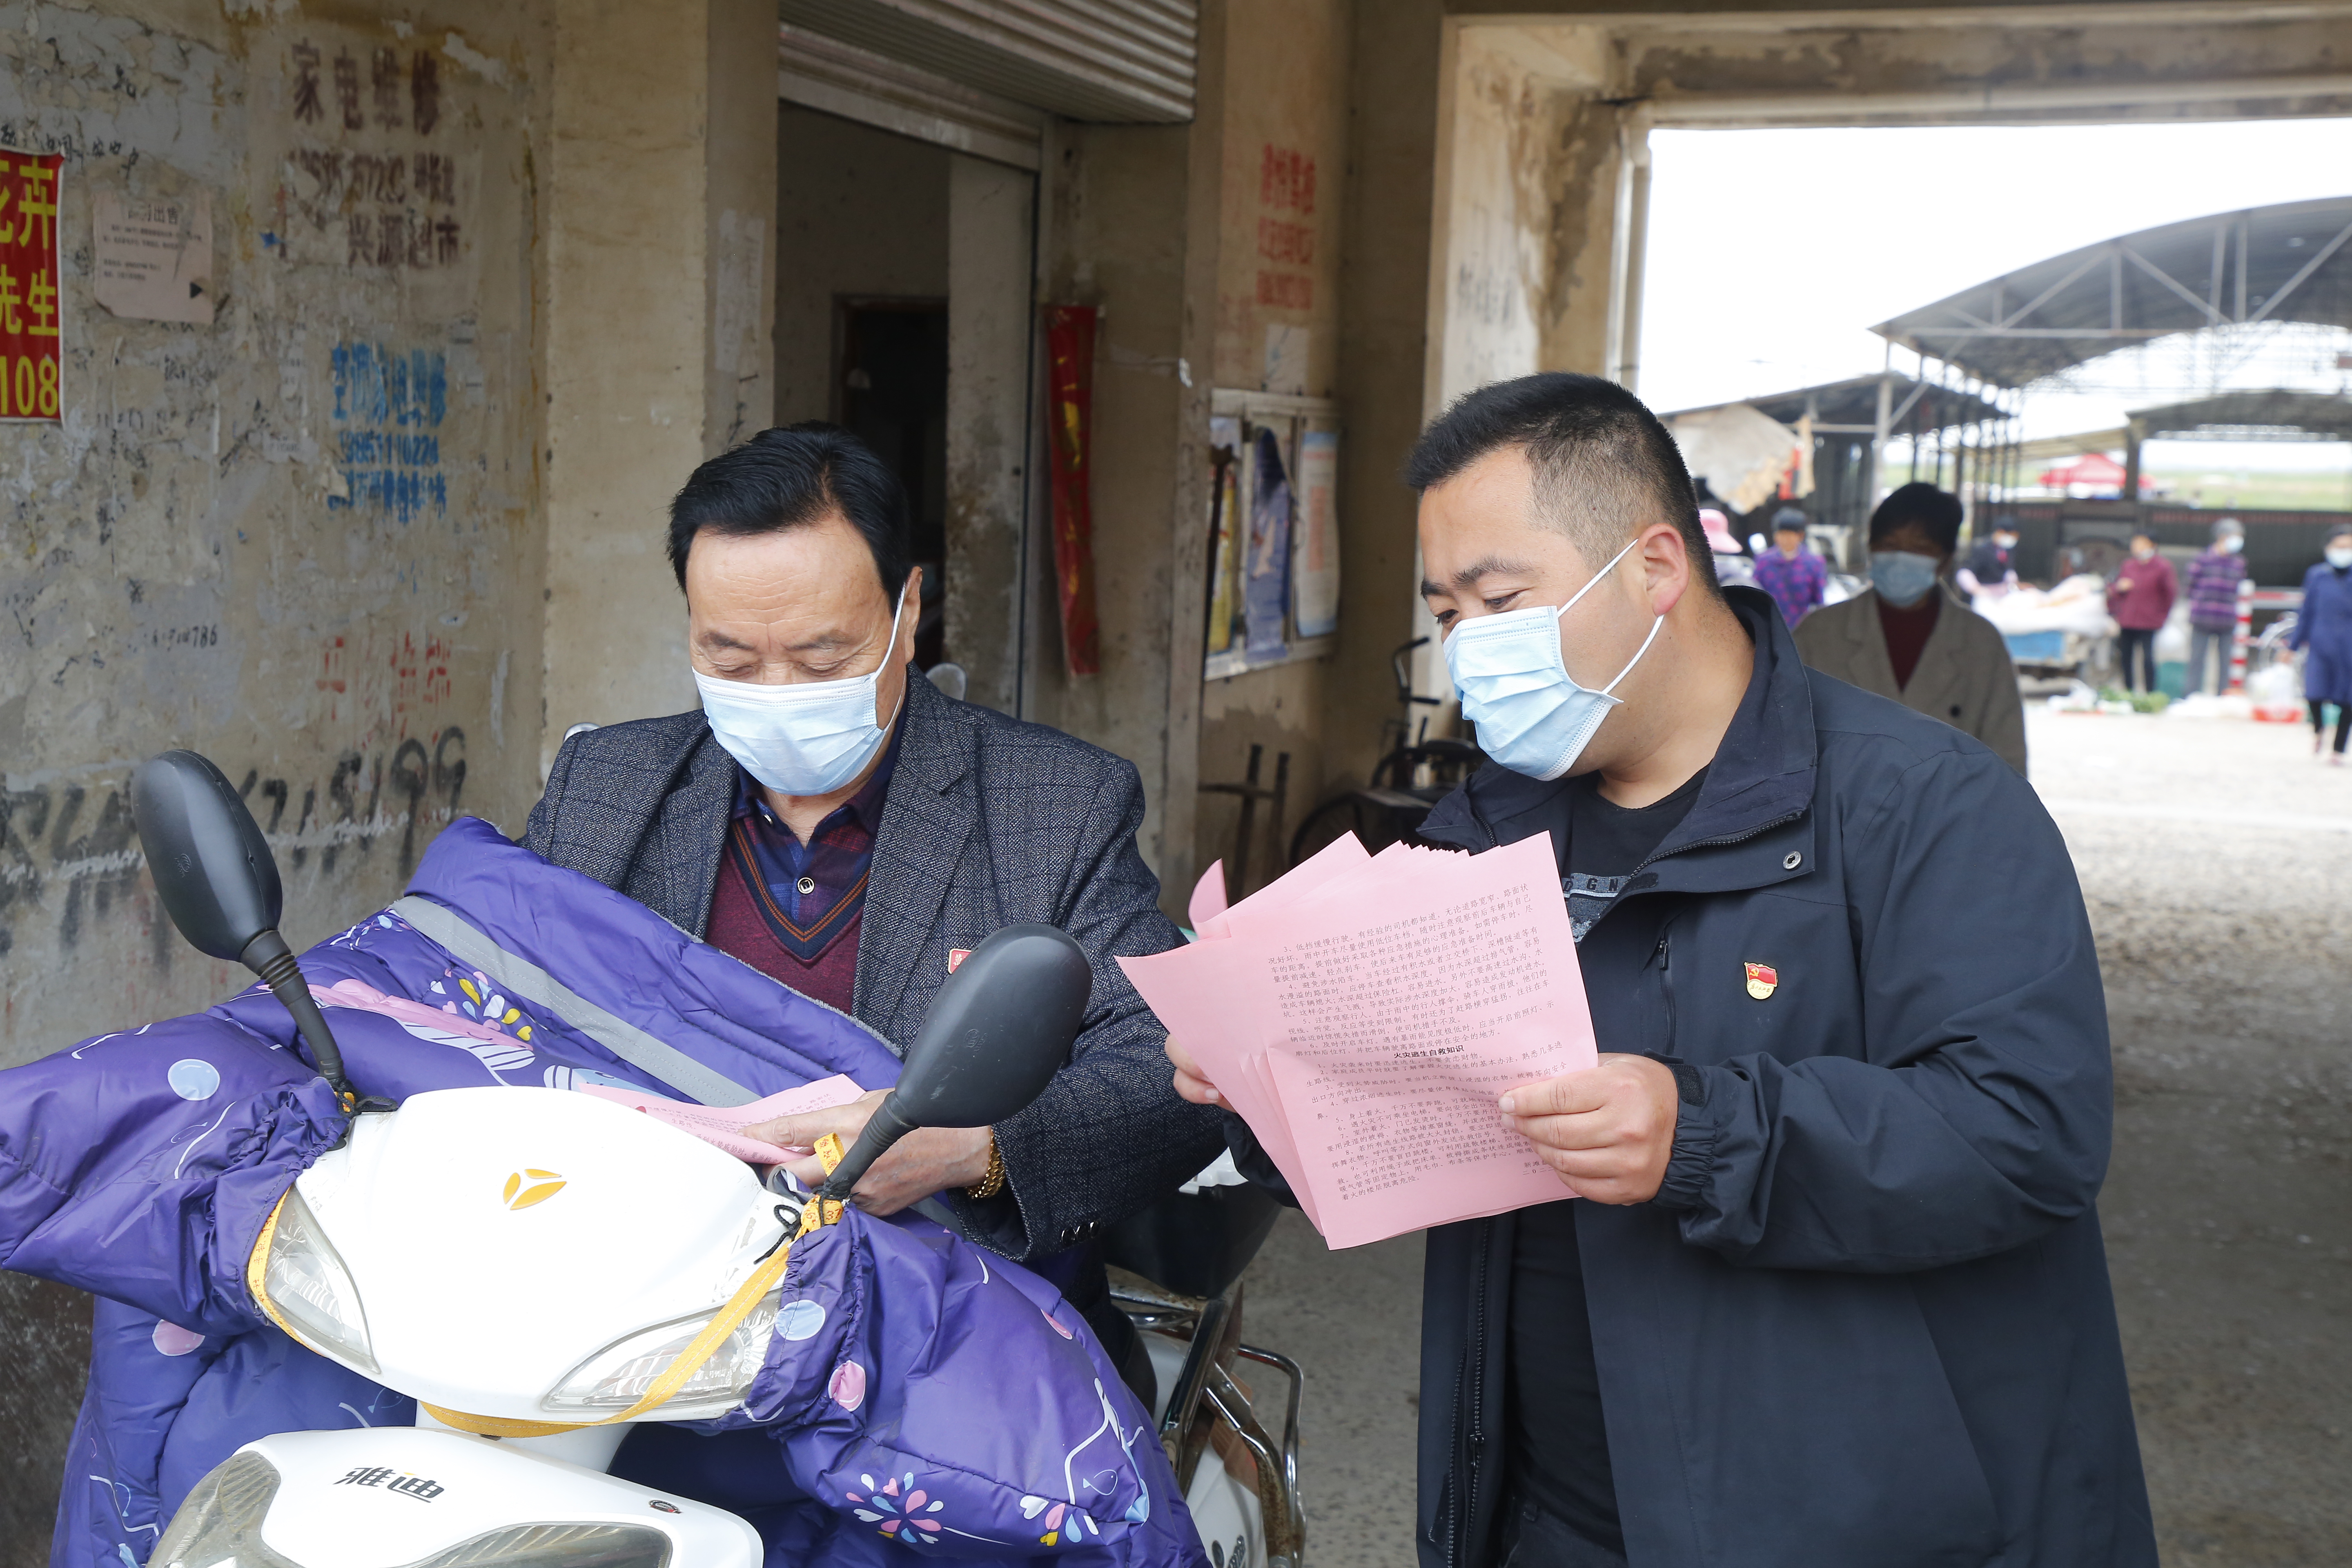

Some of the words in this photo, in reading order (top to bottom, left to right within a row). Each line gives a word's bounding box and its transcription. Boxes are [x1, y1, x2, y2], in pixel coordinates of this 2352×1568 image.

[1394, 1045, 1464, 1059] 火灾逃生自救知识
[1306, 1076, 1334, 1087] 生路线。
[1311, 1087, 1366, 1104] 出口方向冲出。
[1316, 1113, 1328, 1121] 鼻。
[1338, 1103, 1499, 1131] 6、遇火灾不可乘坐电梯，要向安全出口方
[1341, 1175, 1420, 1201] 着火的楼层脱离危险。
[333, 1467, 445, 1503] 雅迪
